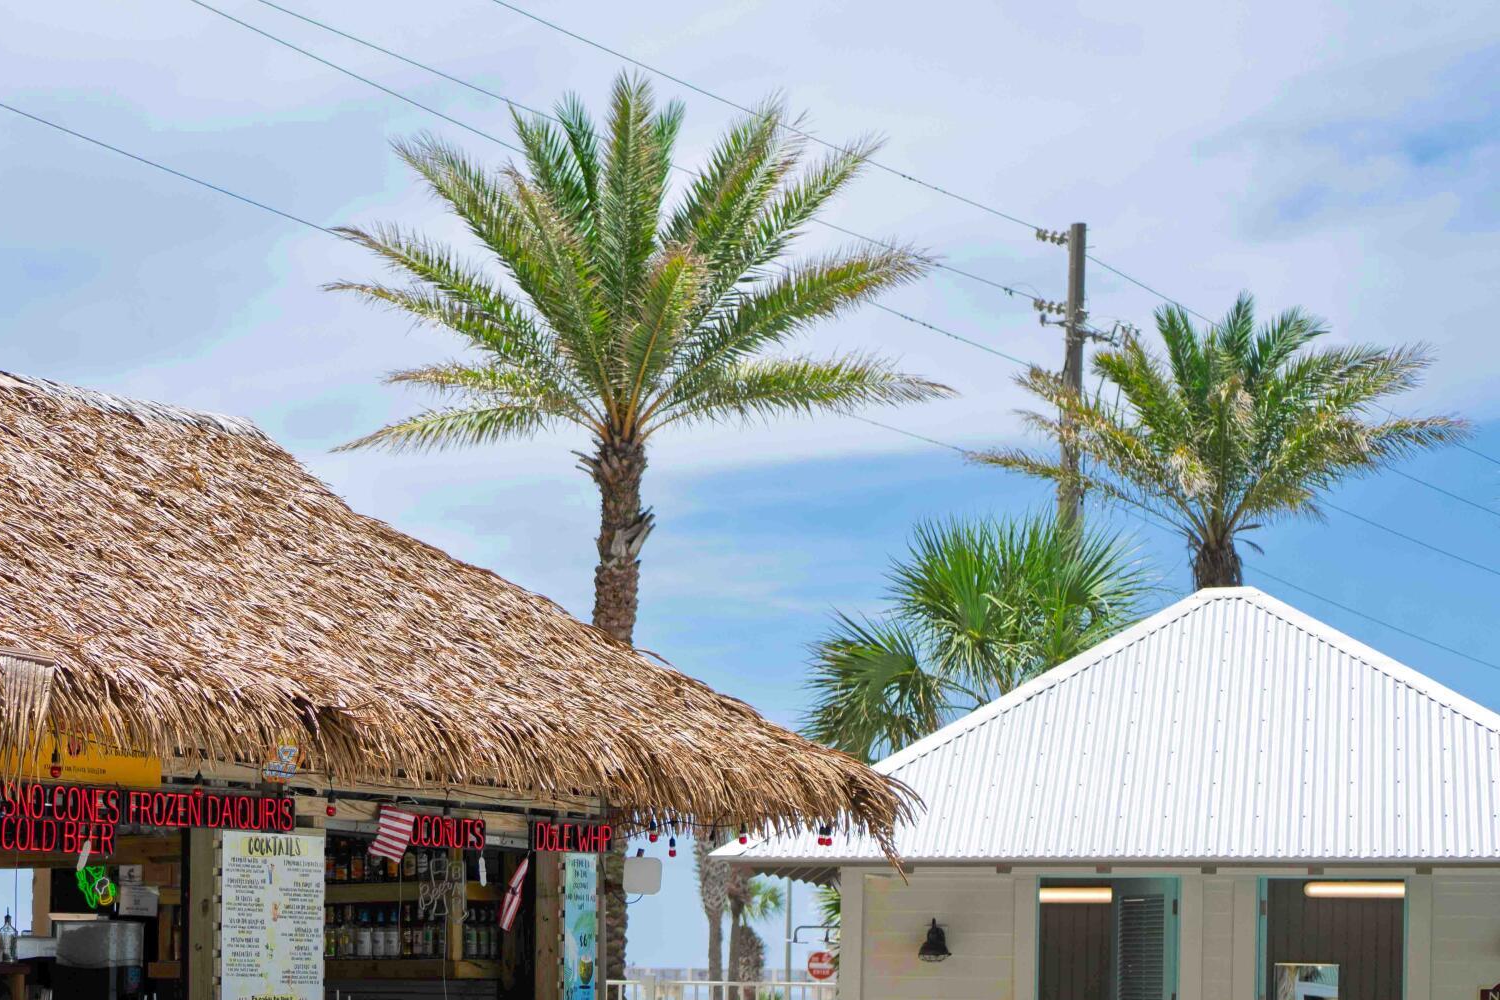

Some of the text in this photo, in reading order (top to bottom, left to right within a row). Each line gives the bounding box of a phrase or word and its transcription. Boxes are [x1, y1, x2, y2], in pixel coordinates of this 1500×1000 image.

[2, 782, 120, 824] SNO CONES
[129, 791, 293, 831] FROZEN DAIQUIRIS
[1, 817, 115, 855] COLD BEER
[248, 836, 302, 857] COCKTAILS
[411, 815, 486, 849] OCONUTS
[536, 822, 572, 852] DOLE
